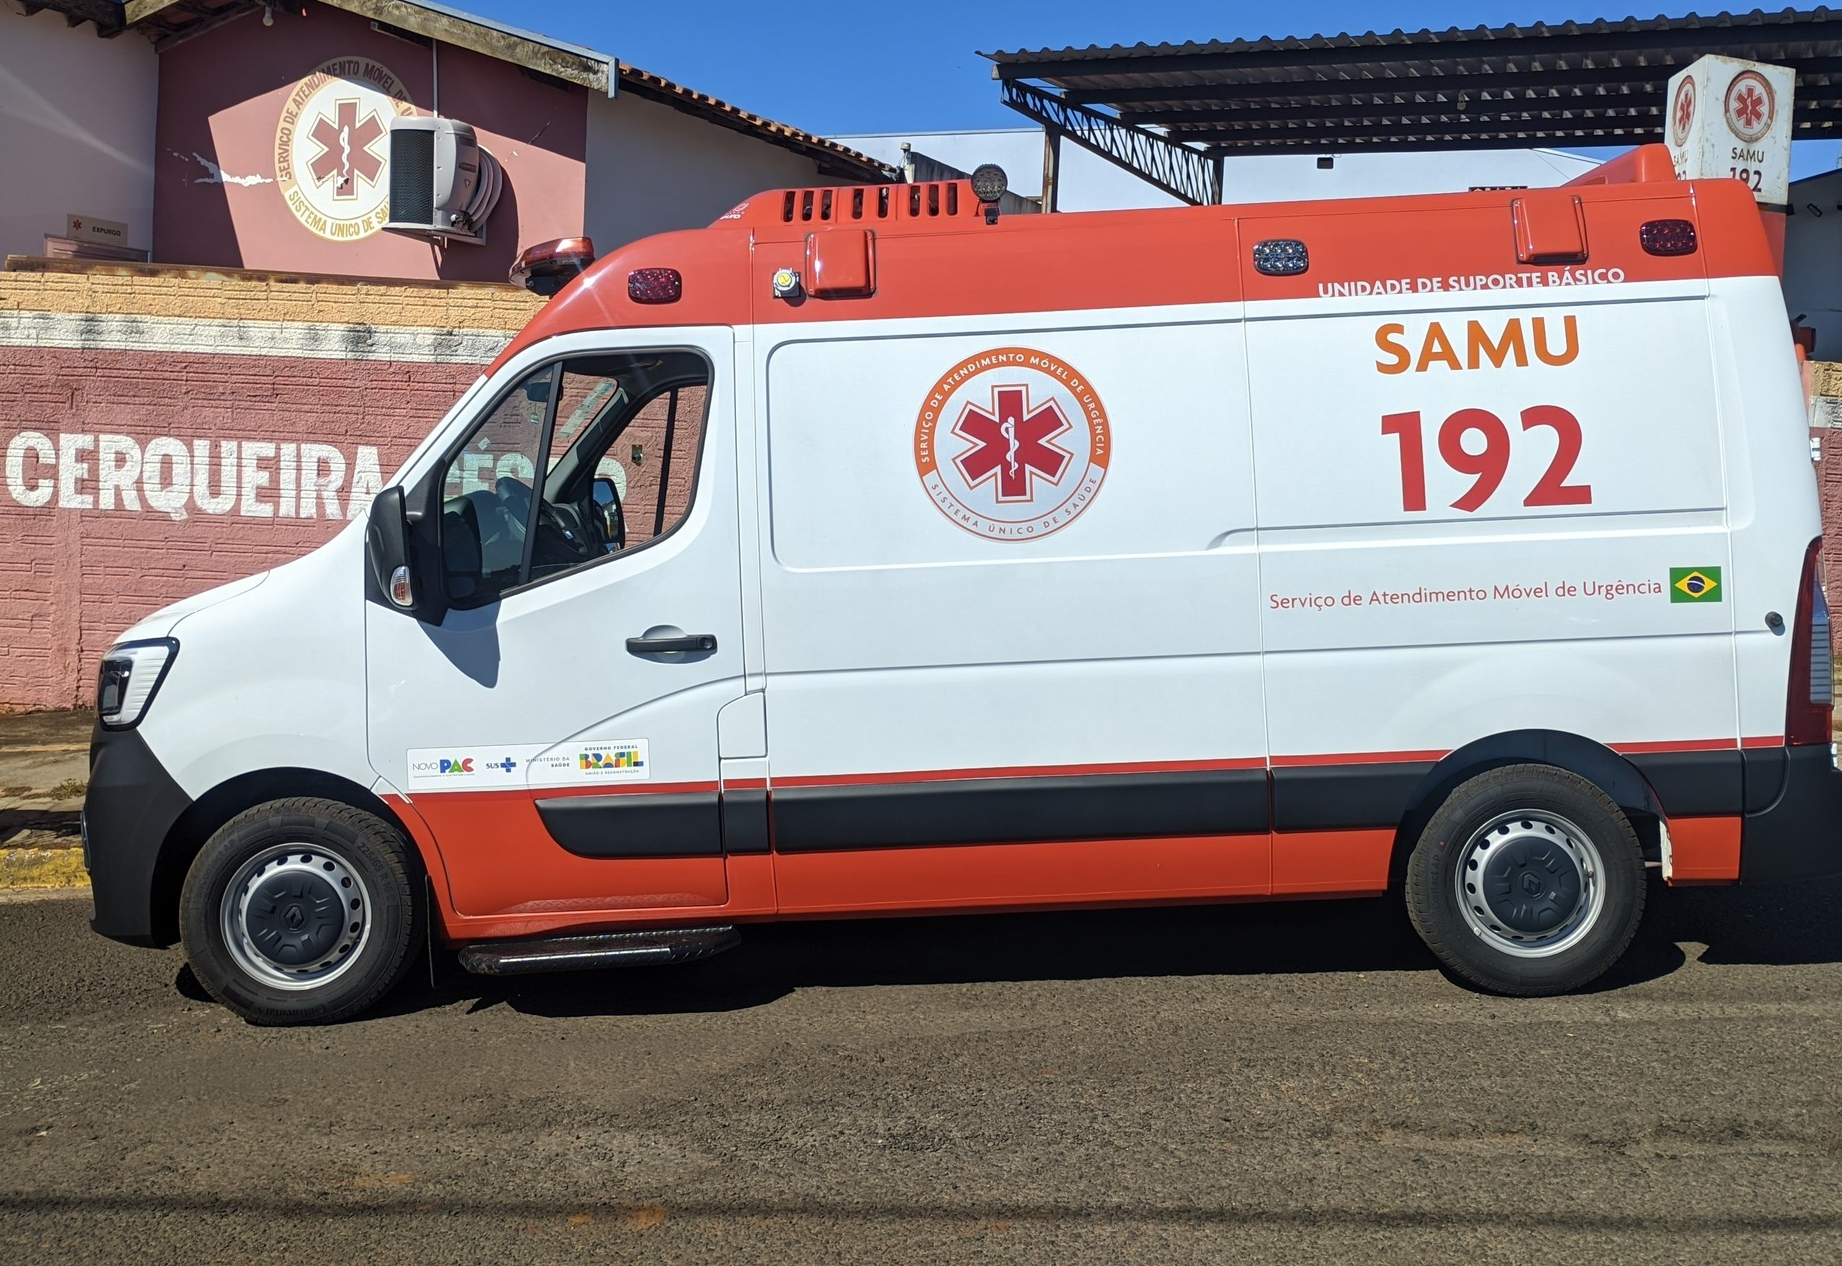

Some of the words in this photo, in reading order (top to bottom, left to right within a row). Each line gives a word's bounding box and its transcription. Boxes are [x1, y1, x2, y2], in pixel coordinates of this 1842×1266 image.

[283, 107, 298, 125] DE
[292, 60, 360, 110] ATENDIMENTO
[363, 61, 394, 94] MÓVEL
[393, 88, 408, 108] DE
[1731, 147, 1764, 163] SAMU
[1730, 167, 1763, 193] 192
[288, 190, 327, 234] SISTEMA
[330, 220, 360, 237] ÚNICO
[361, 216, 375, 233] DE
[92, 226, 121, 237] EXPURGO
[1318, 278, 1412, 298] UNIDADE
[1418, 277, 1444, 293] DE
[1448, 272, 1543, 292] SUPORTE
[1547, 266, 1625, 287] BÁSICO
[1374, 315, 1580, 375] SAMU
[920, 411, 933, 463] SERVIÇO
[930, 392, 943, 408] DE
[942, 353, 1025, 391] ATENDIMENTO
[1029, 355, 1068, 380] MÓVEL
[1070, 378, 1085, 393] DE
[1083, 394, 1105, 456] URGÊNCIA
[6, 431, 384, 521] CERQUEIRA
[1381, 405, 1593, 513] 192
[931, 484, 979, 528] SISTEMA
[988, 521, 1035, 535] ÚNICO
[1043, 516, 1059, 528] DE
[1065, 478, 1097, 515] SAÚDE
[1269, 590, 1336, 612] Serviço
[1340, 590, 1364, 607] de
[1368, 585, 1488, 606] Atendimento
[1493, 580, 1550, 600] Móvel
[1554, 580, 1578, 598] de
[1582, 577, 1663, 599] Urgência
[412, 762, 438, 771] NOVO
[439, 758, 474, 773] PAC
[579, 750, 644, 769] BRASIL
[357, 841, 385, 872] 225/65
